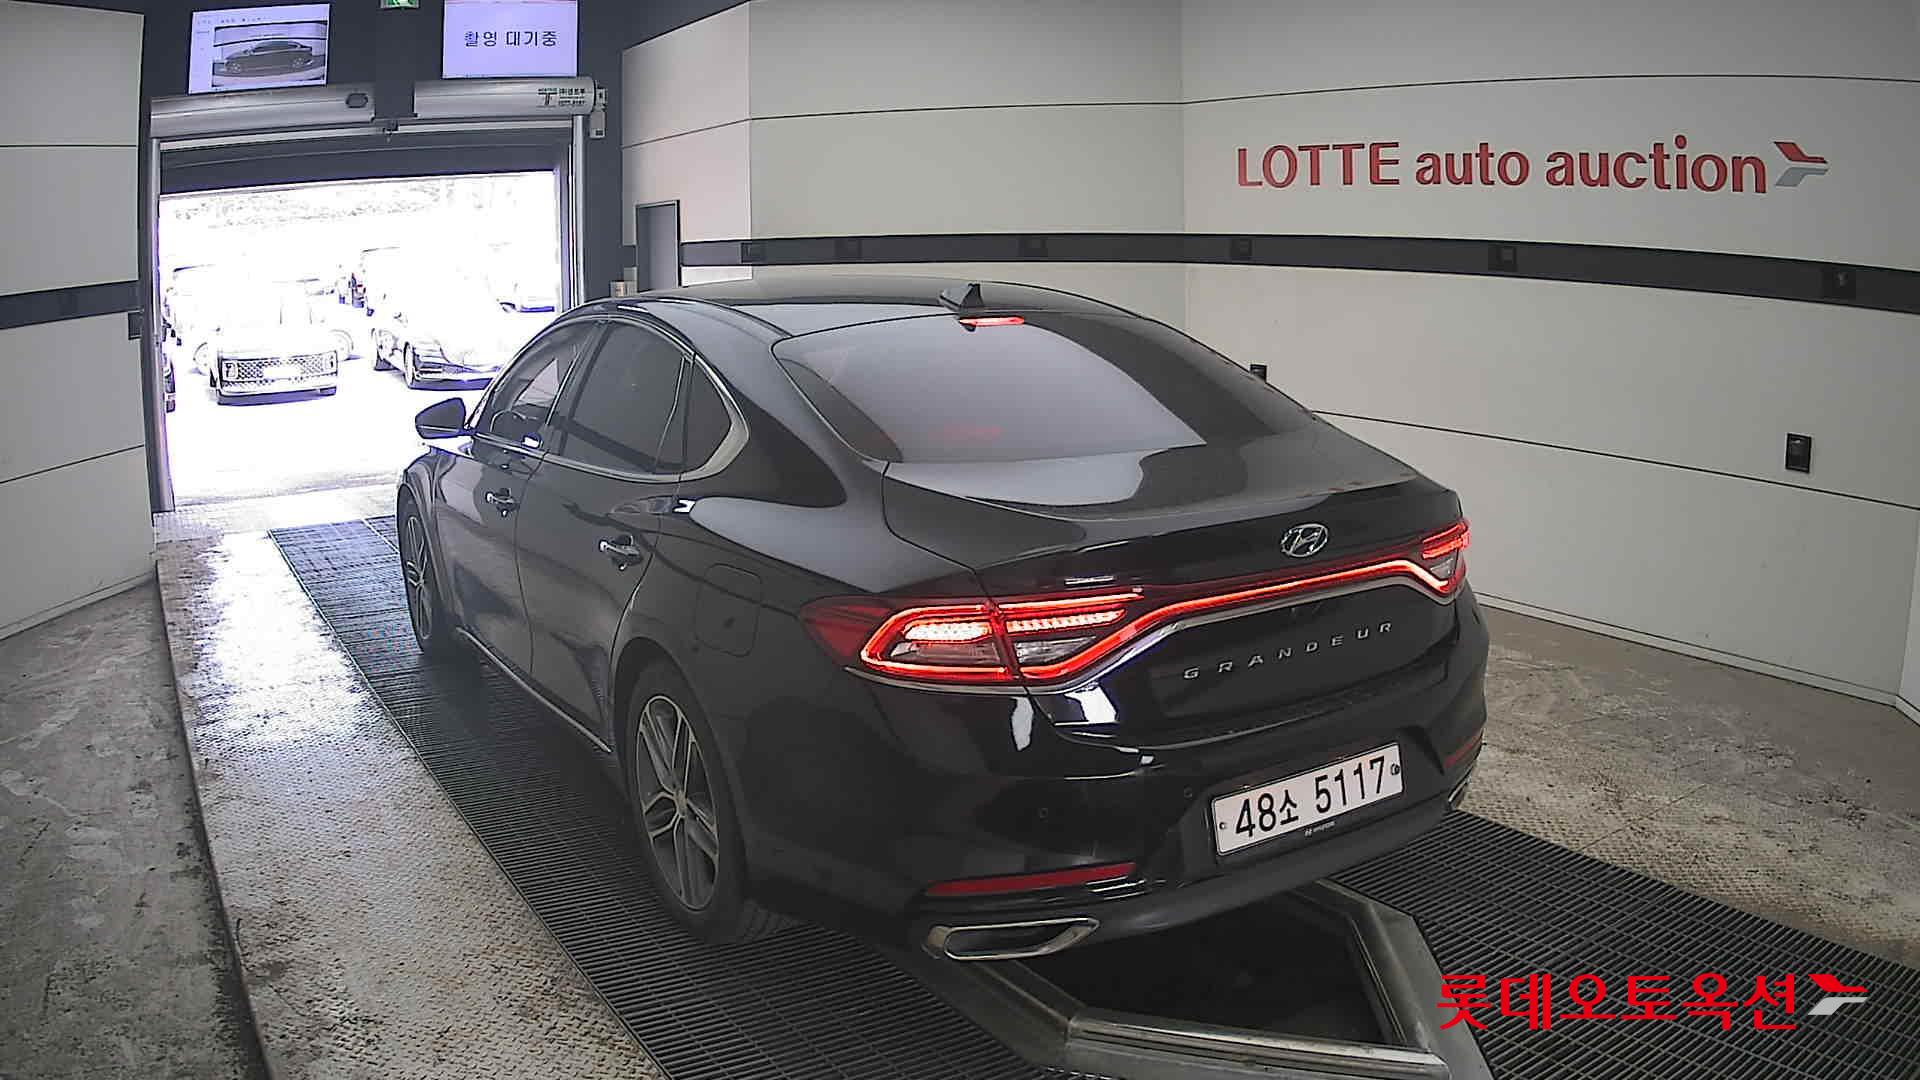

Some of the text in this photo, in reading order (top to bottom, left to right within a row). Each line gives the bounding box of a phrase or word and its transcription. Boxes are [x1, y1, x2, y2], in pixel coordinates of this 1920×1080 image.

[464, 30, 558, 47] 촬영 대기중
[1237, 133, 1767, 194] LOTTE auto auction
[1183, 622, 1392, 680] GRANDEUR
[1235, 756, 1386, 838] 48소 5117
